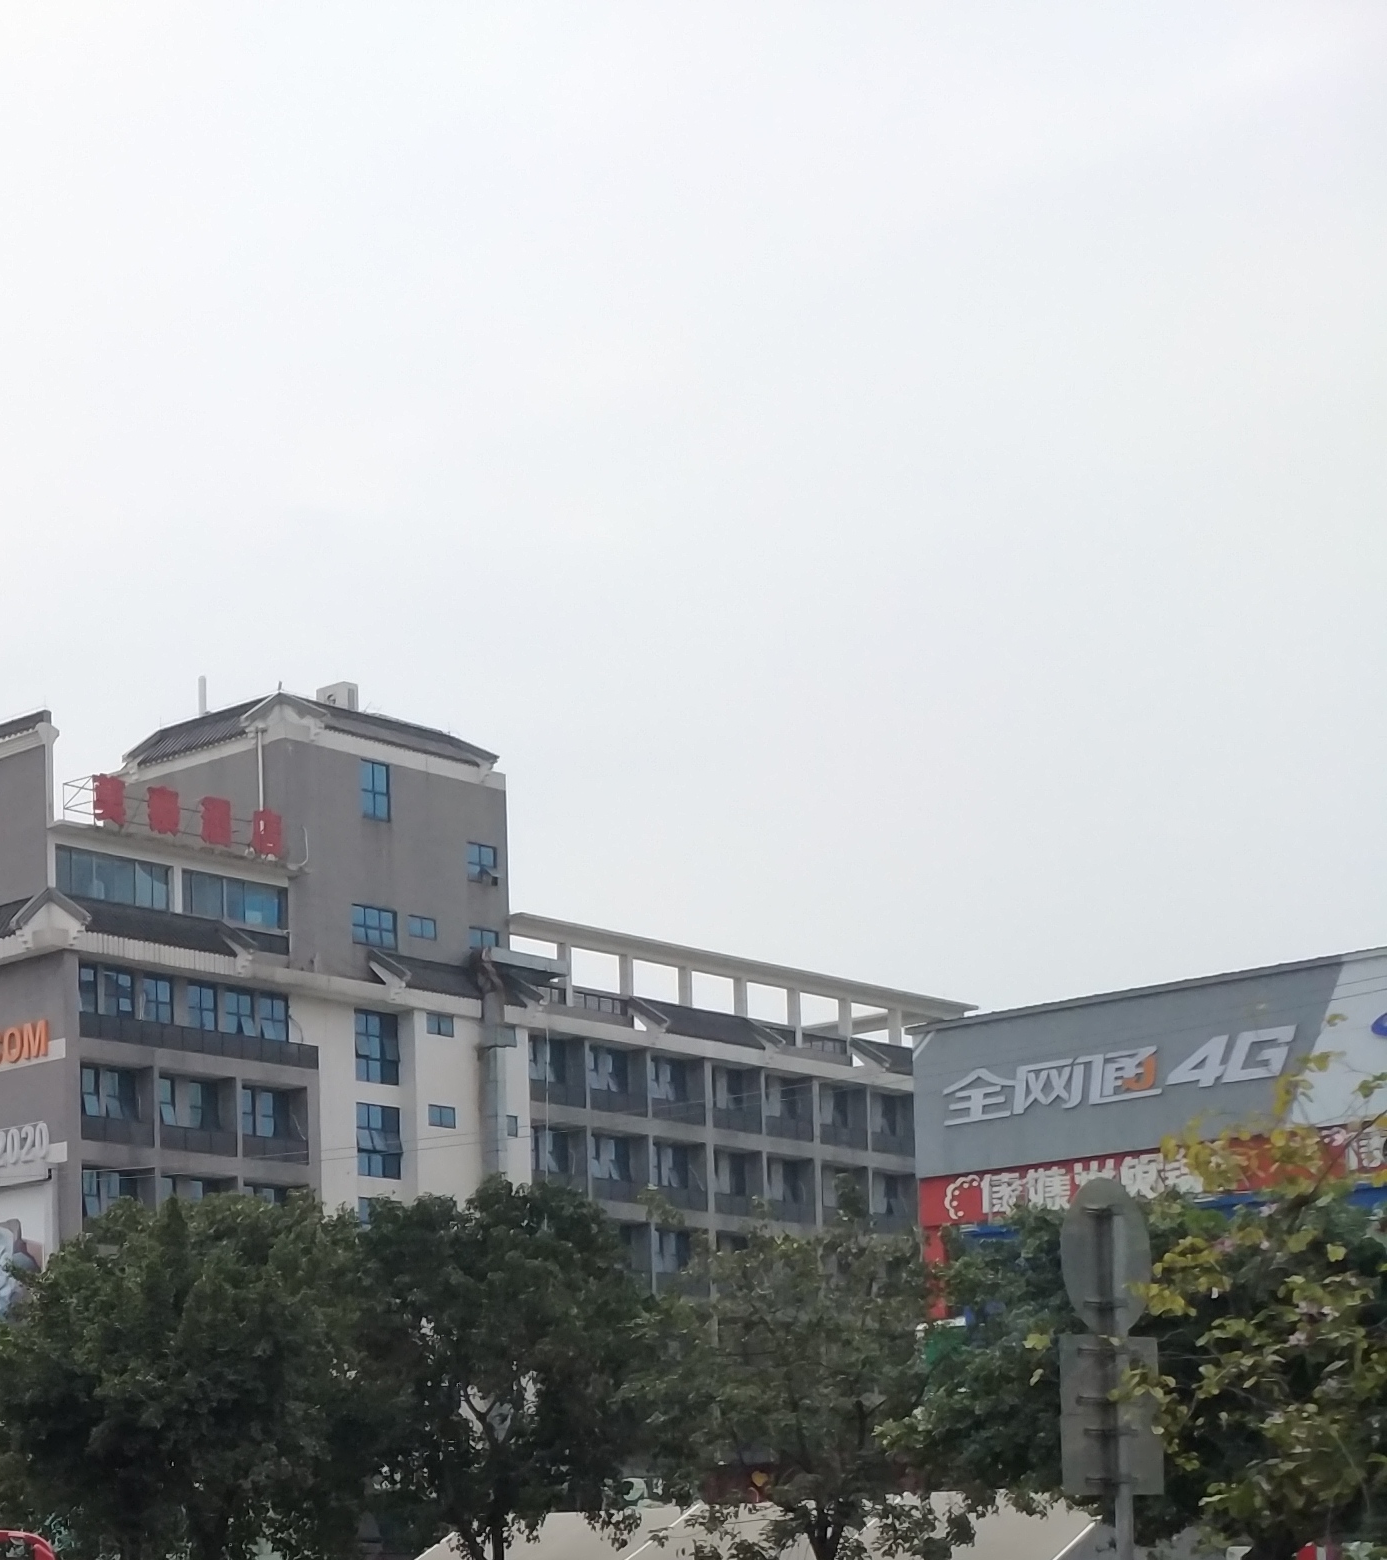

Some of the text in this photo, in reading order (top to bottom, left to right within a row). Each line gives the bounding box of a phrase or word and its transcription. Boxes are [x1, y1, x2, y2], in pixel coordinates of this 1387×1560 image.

[91, 773, 284, 859] 莫泰酒店
[943, 1024, 1298, 1127] 全网通 4G
